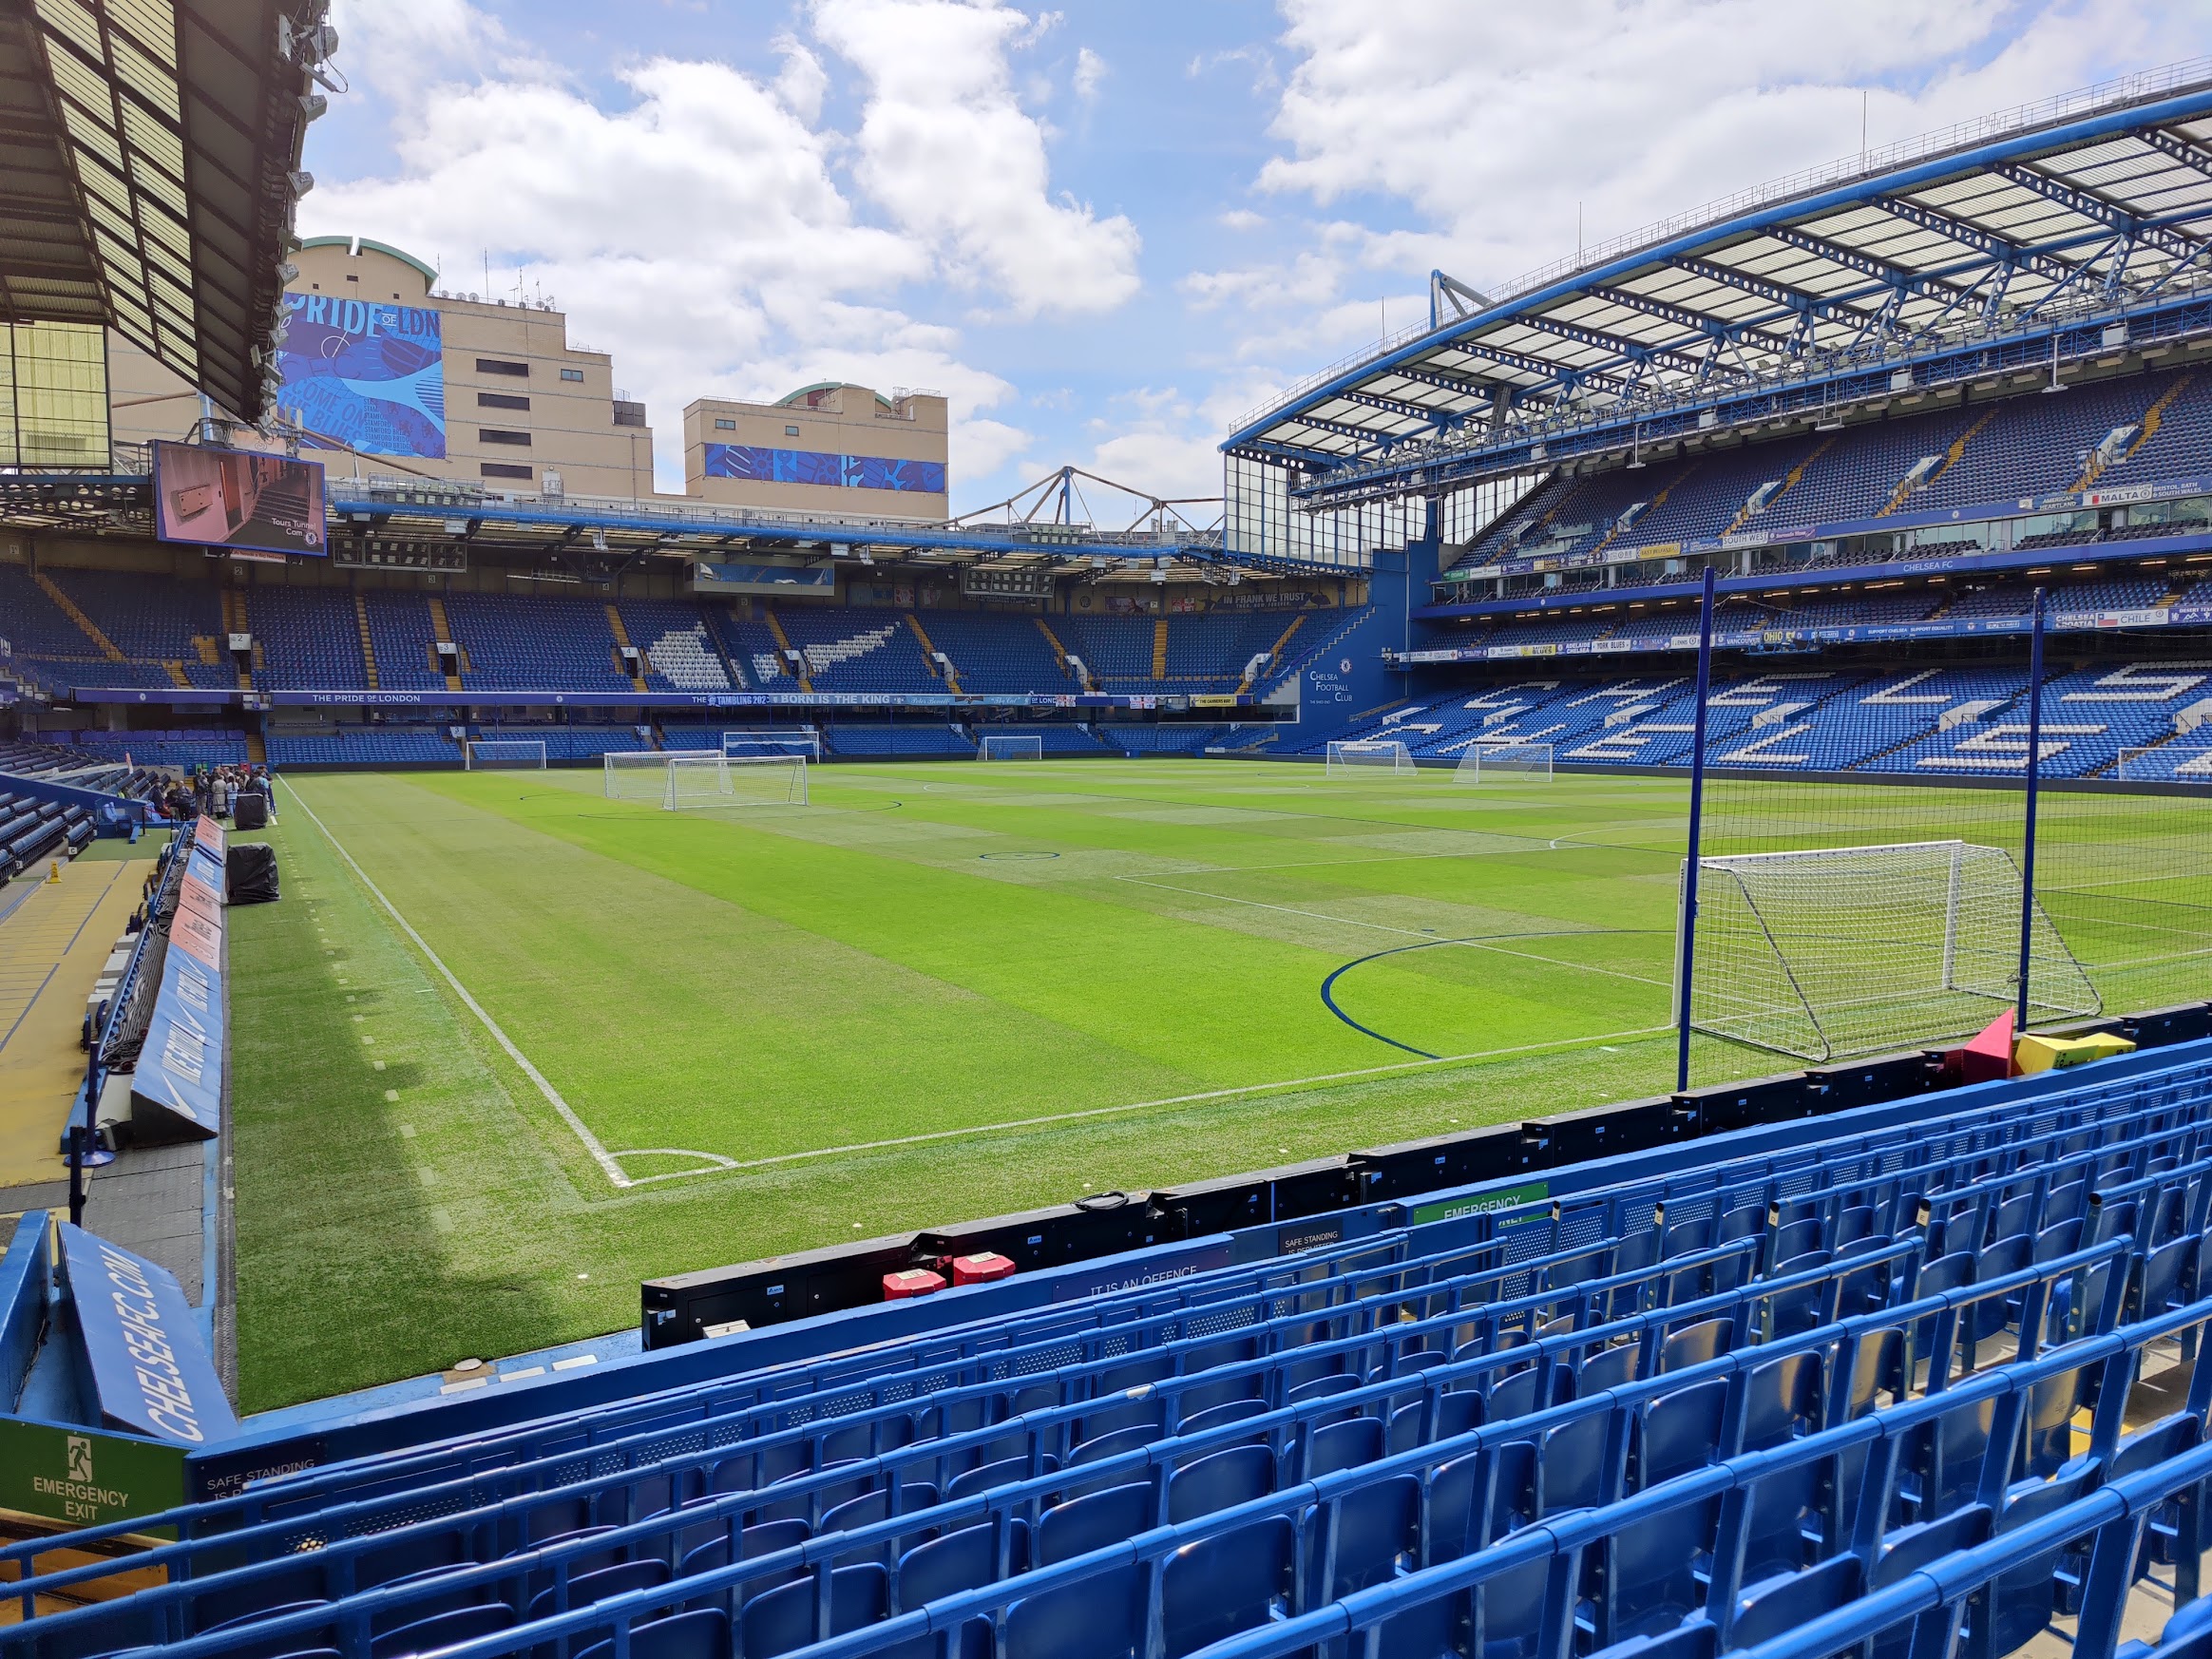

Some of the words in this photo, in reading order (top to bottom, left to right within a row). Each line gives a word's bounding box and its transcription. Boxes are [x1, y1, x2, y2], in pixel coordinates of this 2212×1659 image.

[382, 313, 397, 327] OF
[398, 308, 441, 338] LDN
[292, 378, 341, 415] COME
[342, 403, 366, 429] ON
[313, 406, 364, 440] BLUES
[2042, 495, 2074, 505] AMERICAN
[2101, 492, 2138, 503] MALTA
[2039, 501, 2077, 510] HEARTLAND
[272, 517, 292, 527] Tours
[293, 518, 316, 530] Tunnel
[286, 527, 302, 537] Cam
[1724, 536, 1747, 544] SOUTH
[1748, 532, 1767, 542] WEST
[1641, 548, 1652, 557] EAST
[1652, 546, 1671, 555] BELFAST
[1903, 563, 1940, 572] CHELSEA
[1942, 561, 1953, 569] FC
[1224, 596, 1233, 604] IN
[1235, 594, 1265, 603] FRANK
[1266, 593, 1277, 602] WE
[1280, 592, 1305, 601] TRUST
[2121, 615, 2150, 623] CHILE
[1764, 631, 1783, 642] OHIO
[1596, 641, 1610, 650] YORK
[1309, 671, 1338, 681] CHELSEA
[1315, 681, 1349, 692] FOOTBALL
[367, 695, 376, 703] OF
[716, 696, 752, 705] TAMBLING
[781, 695, 814, 704] BORN
[818, 695, 830, 704] IS
[835, 695, 857, 704] THE
[862, 695, 890, 704] KING
[1334, 692, 1353, 701] CLUB
[1444, 1195, 1521, 1219] EMERGENCY
[1285, 1237, 1303, 1249] SAFE
[1304, 1230, 1338, 1245] STANDING
[1090, 1286, 1103, 1296] IT
[1106, 1283, 1118, 1293] IS
[1122, 1278, 1139, 1289] AN
[1141, 1266, 1197, 1285] OFFENCE
[99, 1245, 204, 1443] CHELSEAFC.COM
[206, 1474, 242, 1491] SAFE
[246, 1459, 315, 1481] STANDING
[33, 1476, 129, 1508] EMERGENCY
[214, 1492, 228, 1500] IS
[65, 1501, 98, 1520] EXIT
